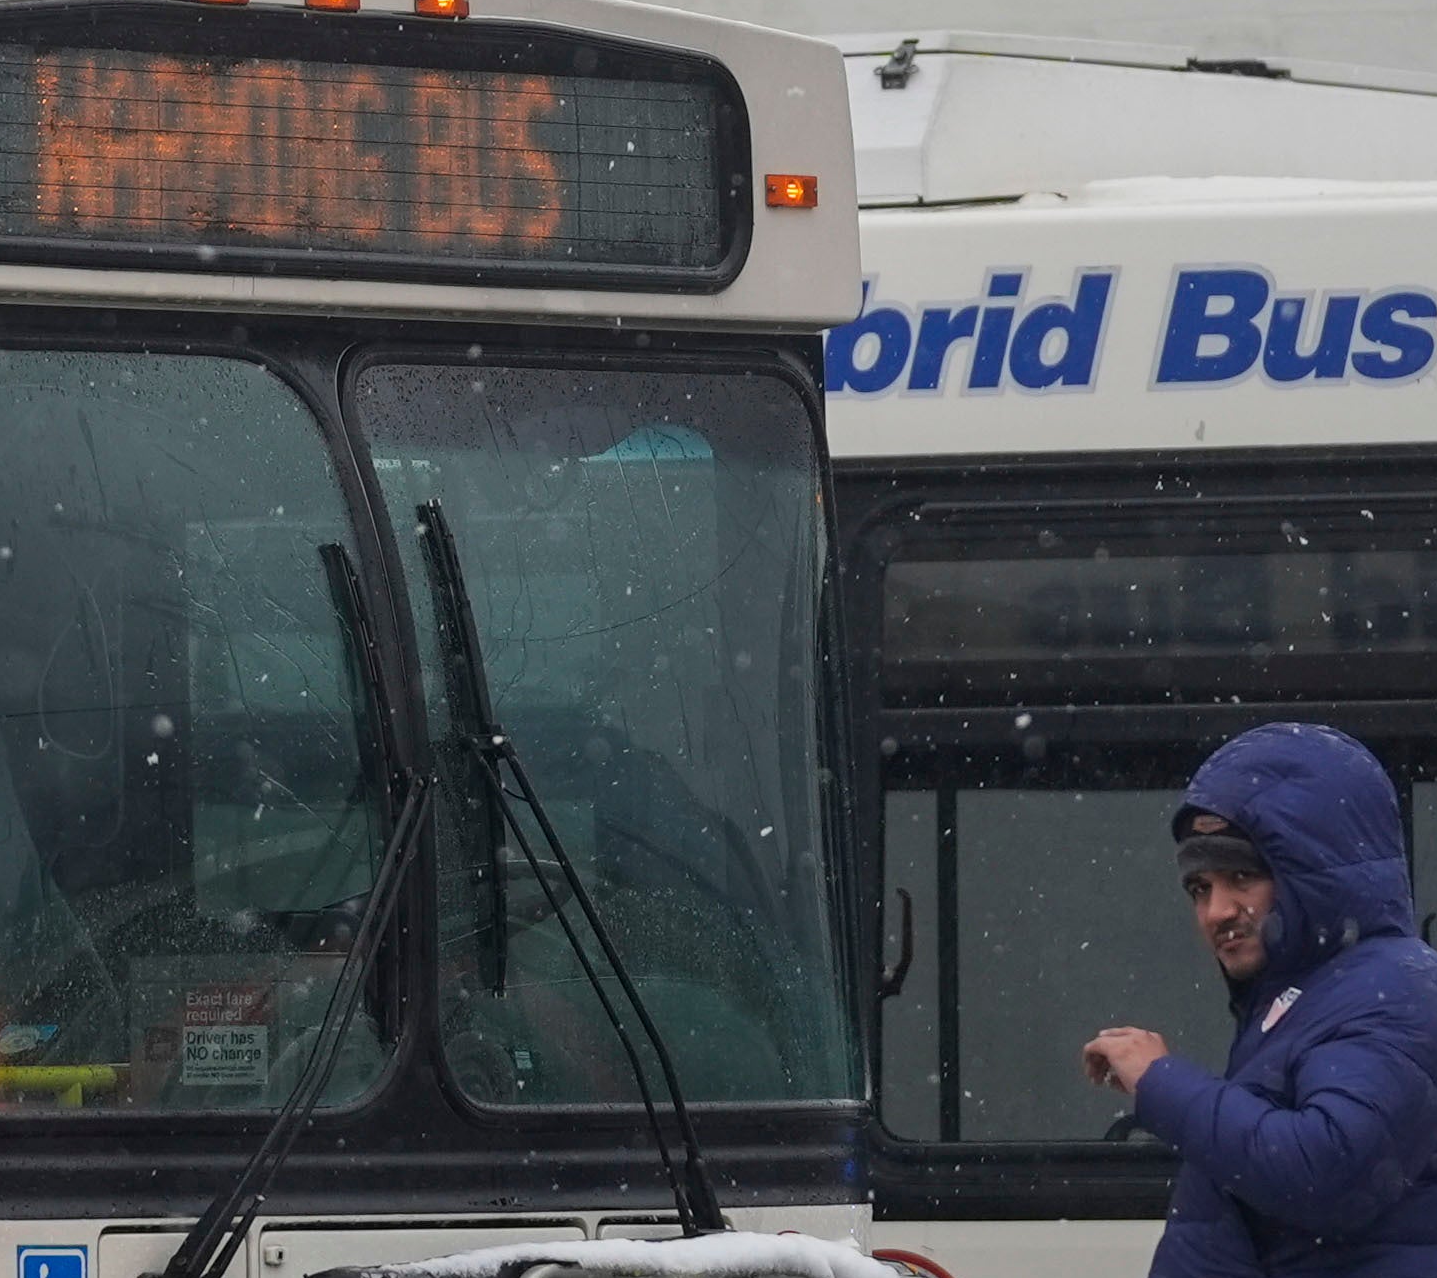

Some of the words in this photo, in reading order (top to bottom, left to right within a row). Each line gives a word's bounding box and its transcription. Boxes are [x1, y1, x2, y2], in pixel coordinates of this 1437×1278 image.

[186, 992, 222, 1006] Exact
[187, 1031, 228, 1045] Driver
[230, 1031, 256, 1045] has
[187, 1046, 209, 1061] NO
[212, 1046, 262, 1063] change
